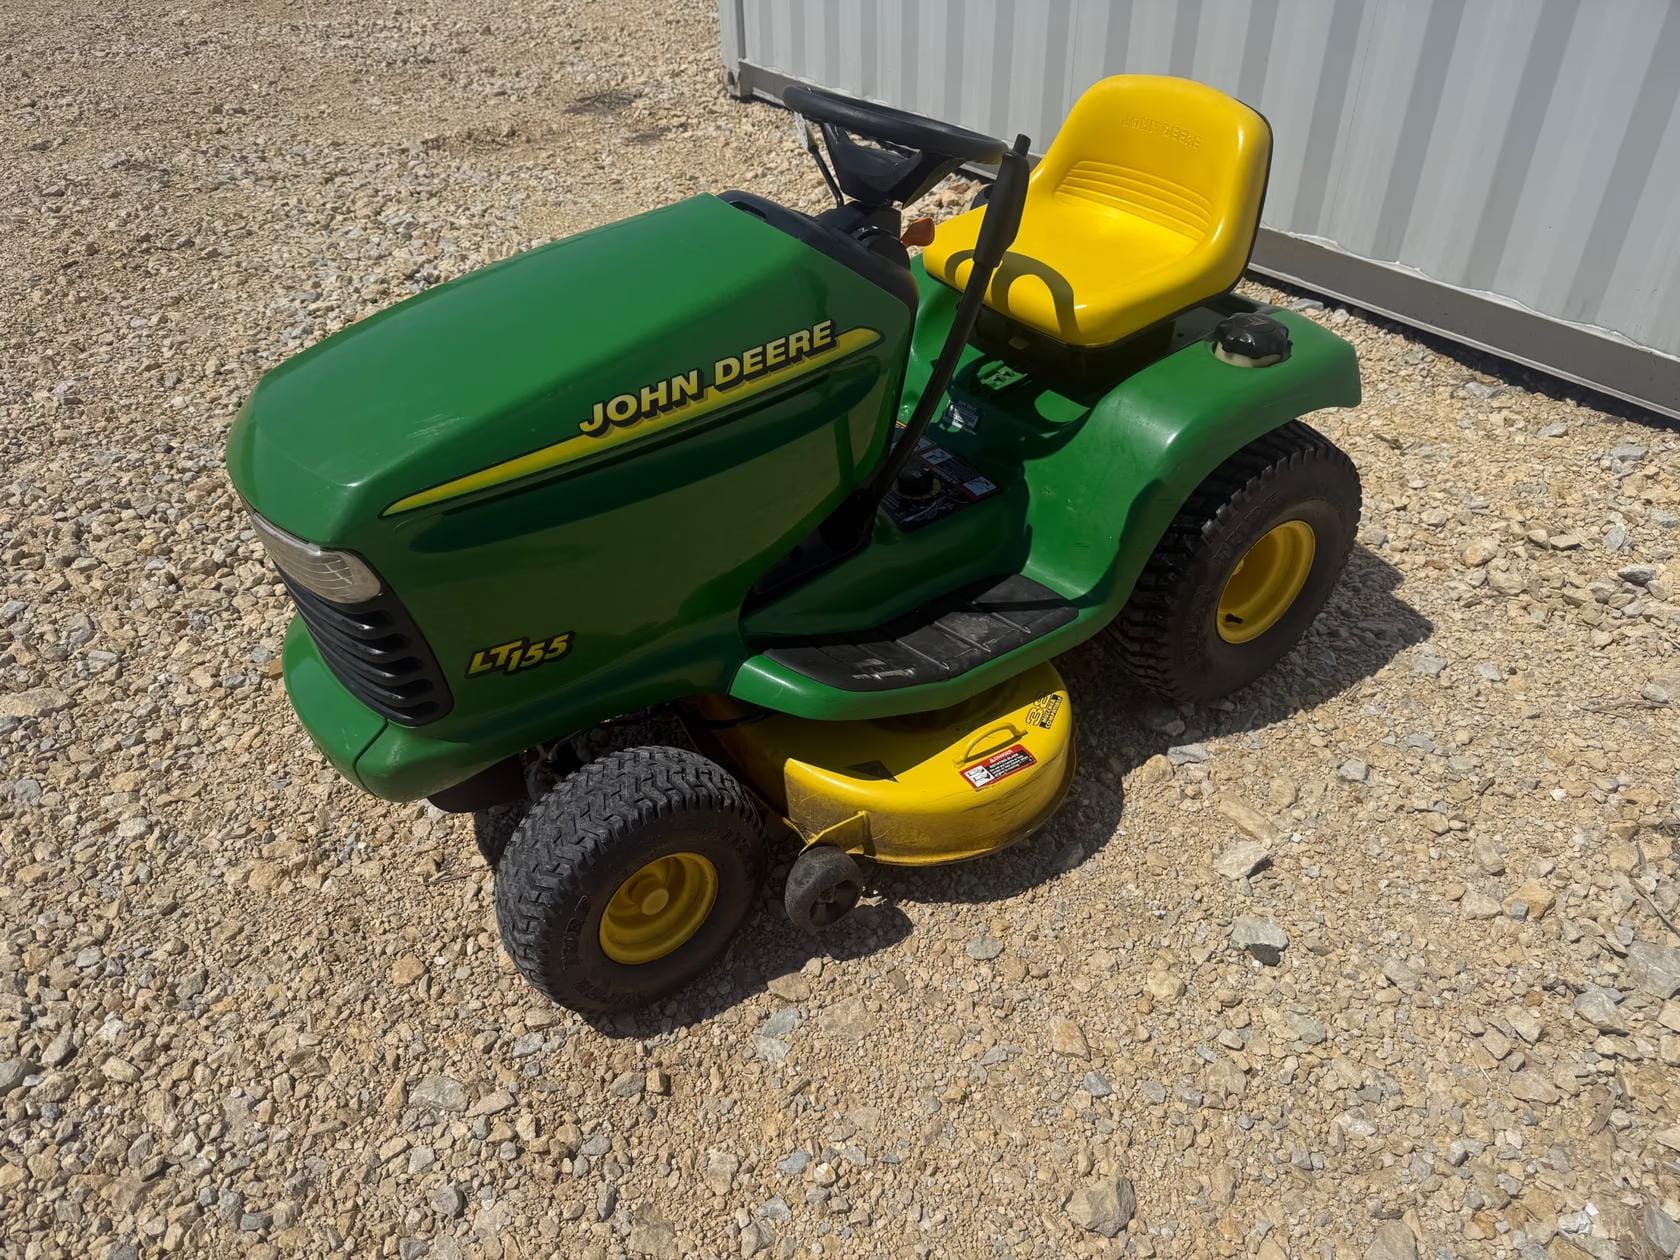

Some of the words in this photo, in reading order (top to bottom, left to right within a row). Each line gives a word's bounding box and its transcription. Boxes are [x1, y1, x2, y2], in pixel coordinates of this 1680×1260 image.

[1162, 126, 1201, 149] DEERE
[578, 368, 703, 436] JOHN
[713, 319, 835, 391] DEERE
[466, 632, 572, 677] LT155
